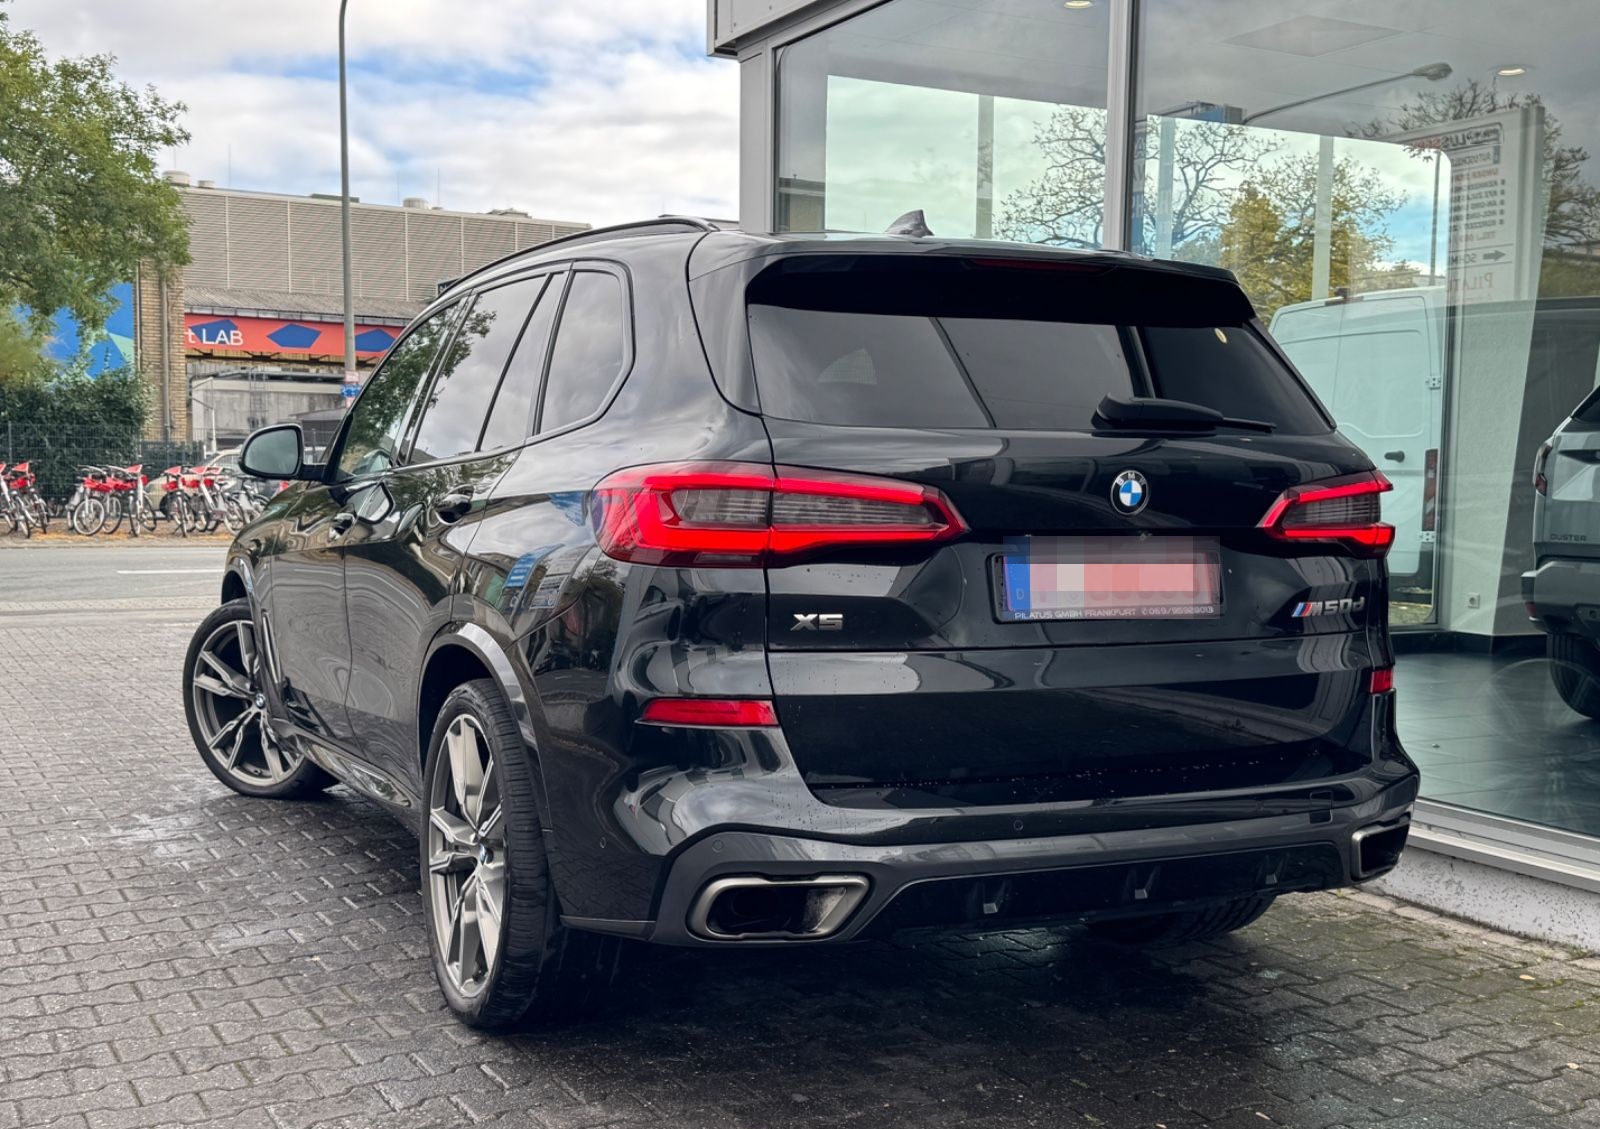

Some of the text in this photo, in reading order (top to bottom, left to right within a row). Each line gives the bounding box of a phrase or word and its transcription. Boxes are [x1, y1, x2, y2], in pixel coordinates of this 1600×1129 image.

[202, 328, 244, 346] LAB
[1014, 611, 1053, 620] PILATUS
[1054, 609, 1082, 619] GMBH
[1084, 607, 1136, 617] FRANKFURT
[1308, 596, 1366, 617] M50d
[790, 613, 844, 631] X5
